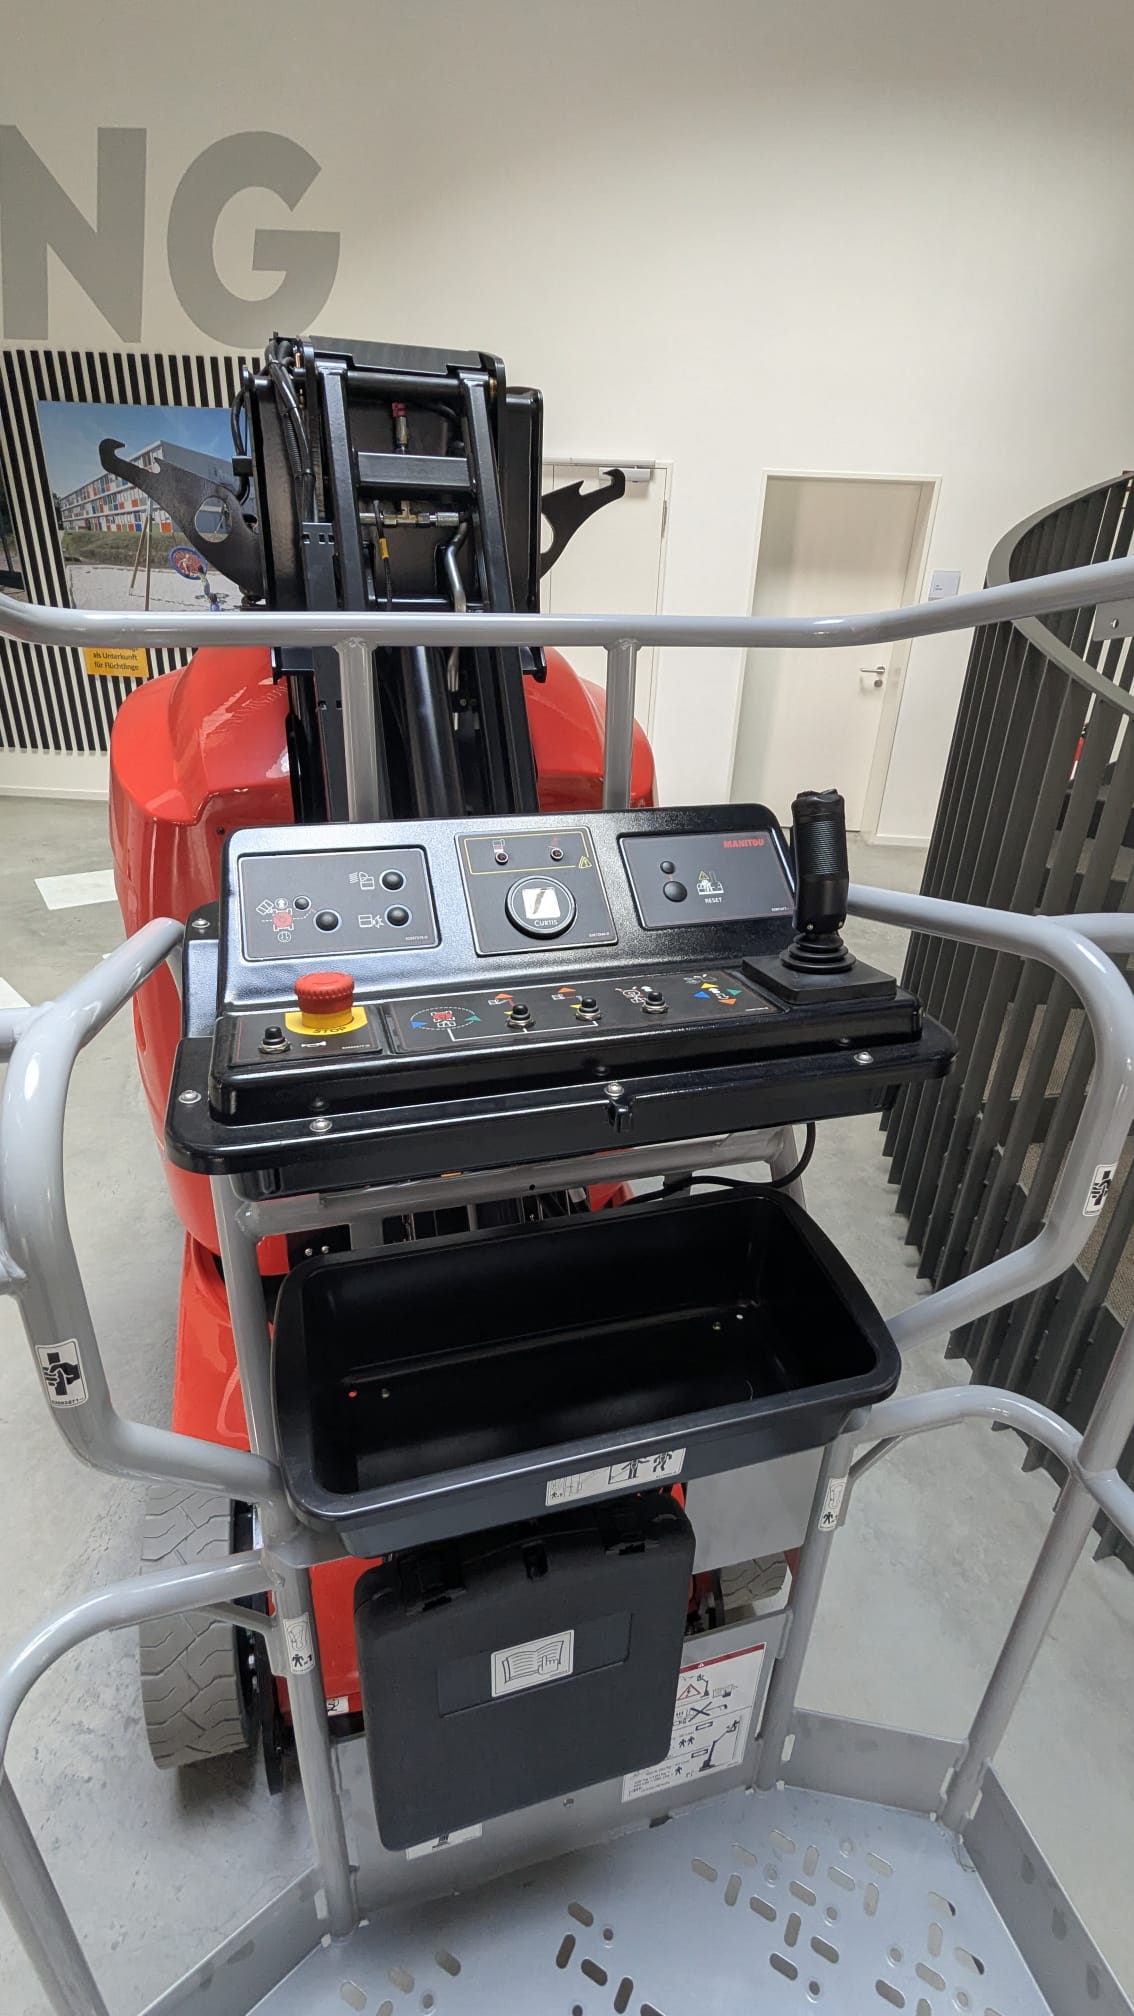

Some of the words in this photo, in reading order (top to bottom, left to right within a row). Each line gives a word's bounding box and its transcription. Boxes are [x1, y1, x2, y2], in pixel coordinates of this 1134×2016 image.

[0, 124, 341, 349] NG
[102, 652, 137, 661] Unterkunft
[104, 662, 139, 671] Flüchtlinge
[723, 838, 765, 848] MANITOU
[313, 1026, 347, 1034] STOP
